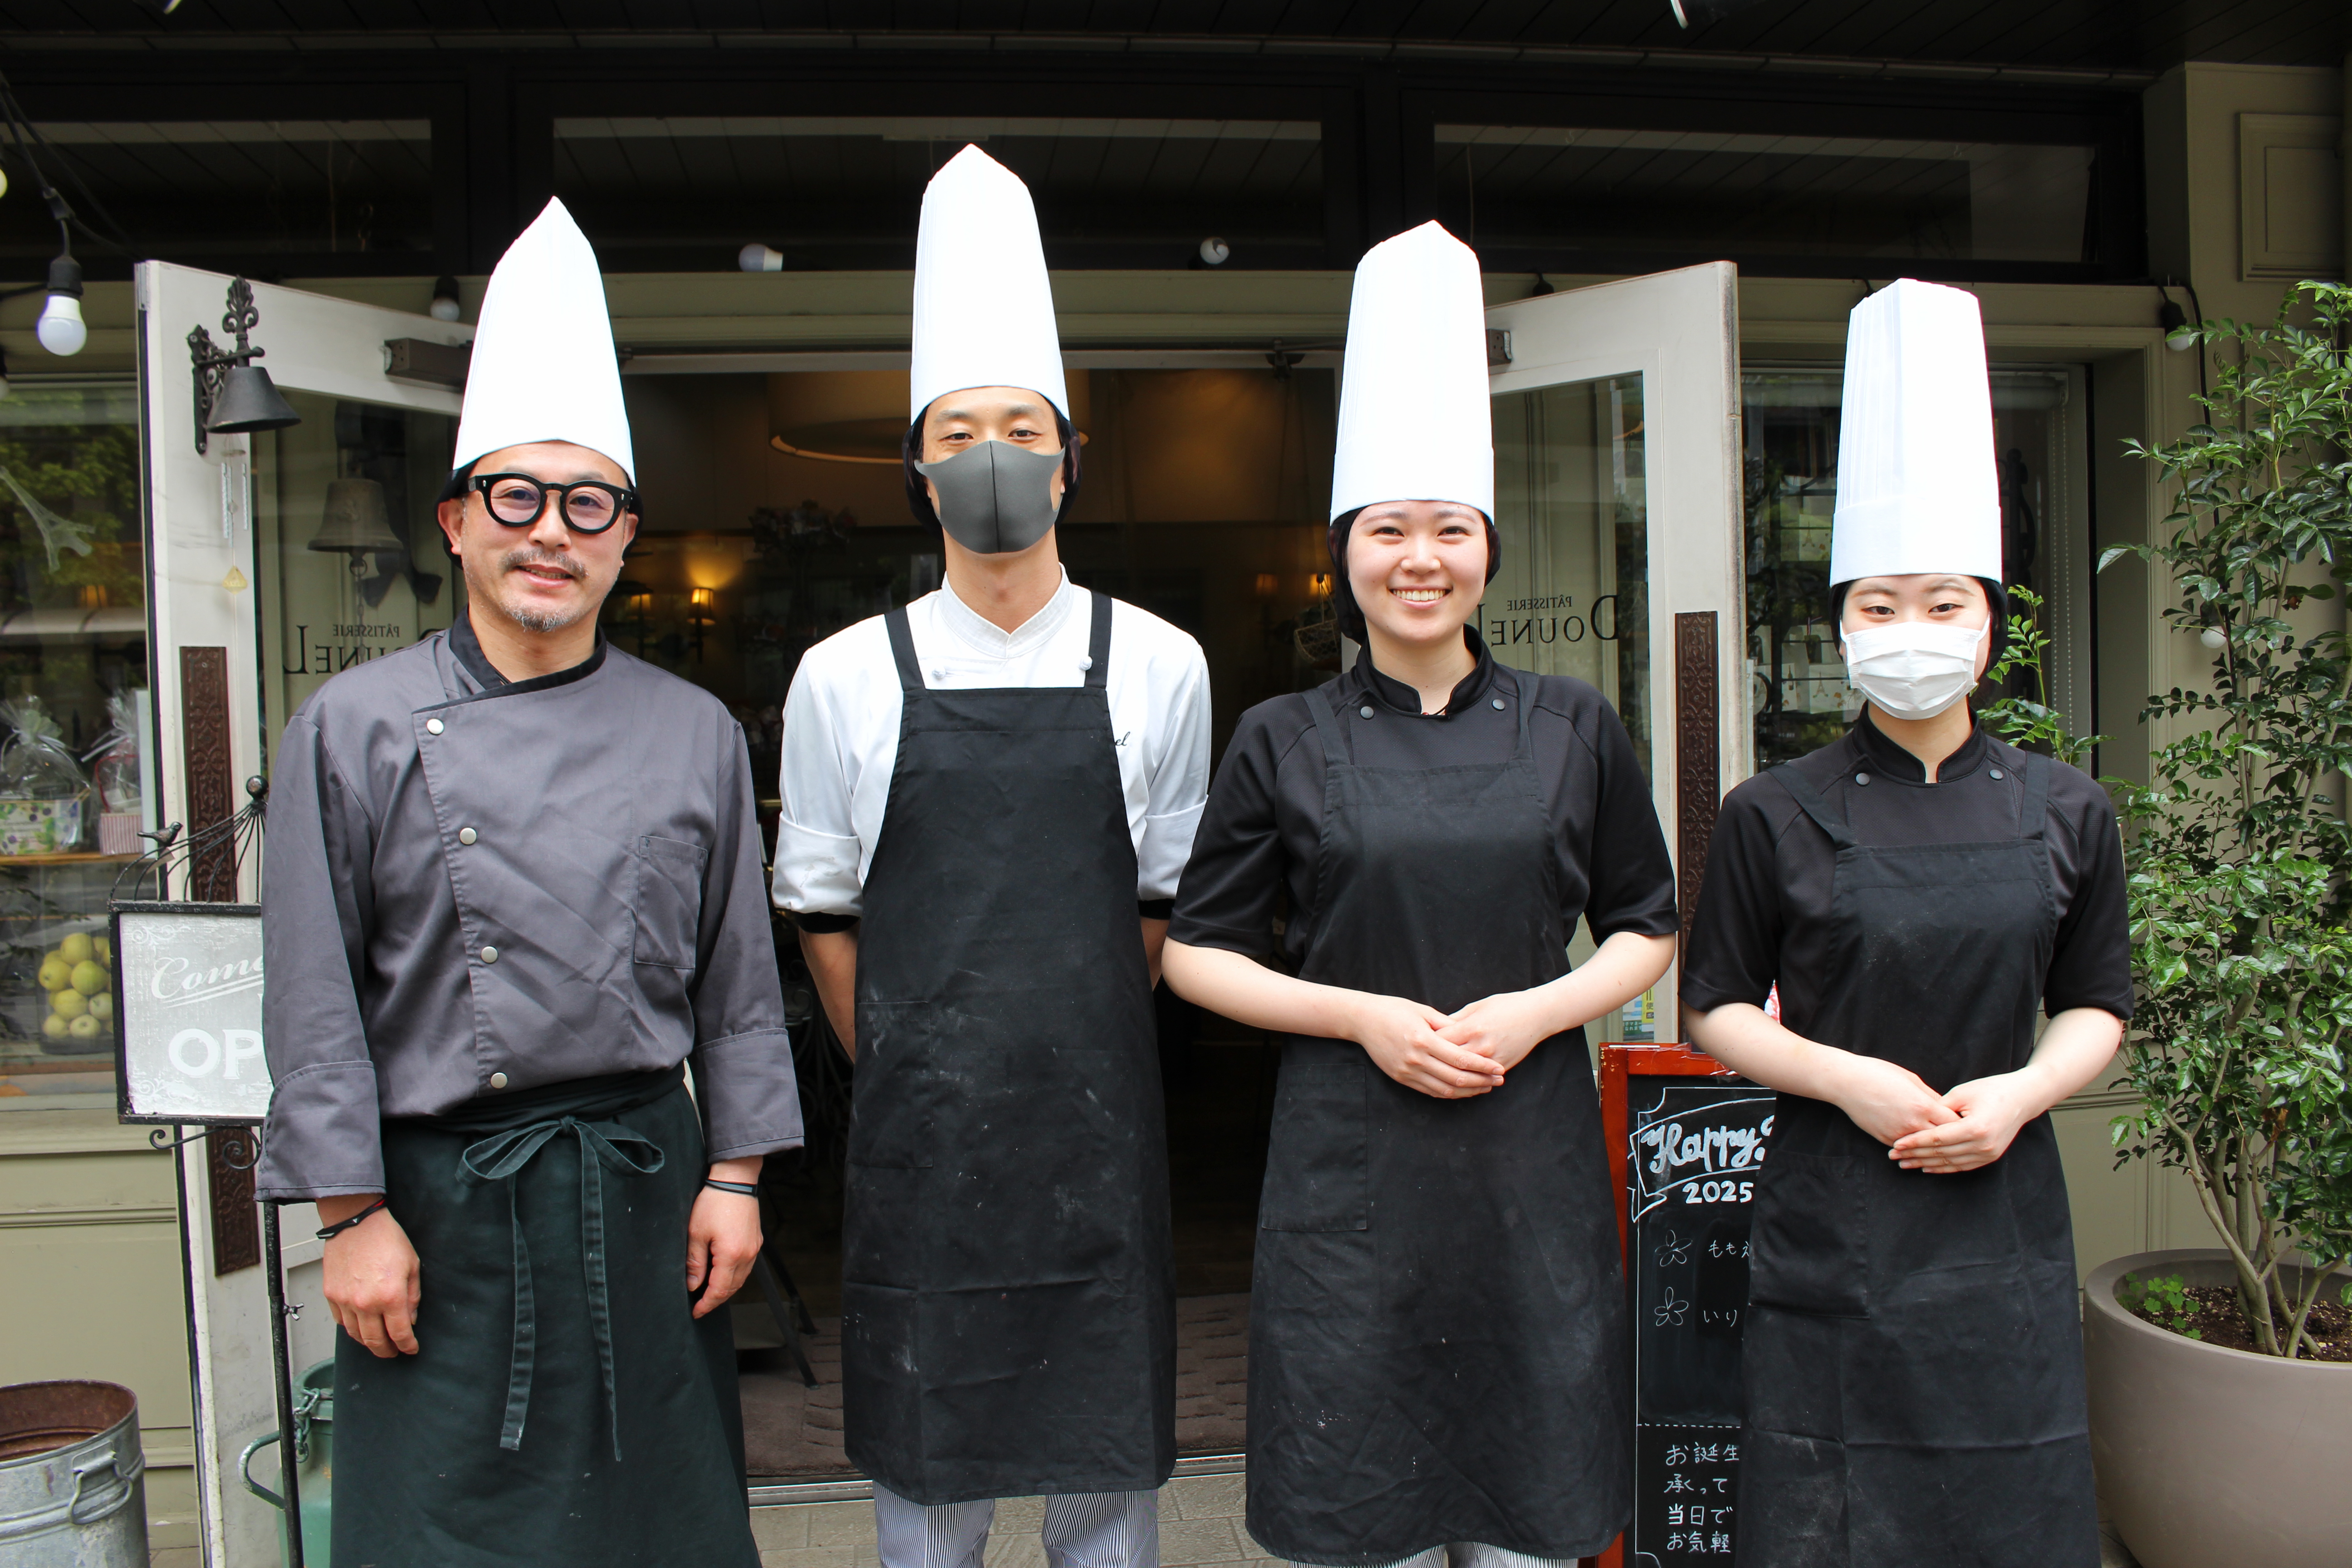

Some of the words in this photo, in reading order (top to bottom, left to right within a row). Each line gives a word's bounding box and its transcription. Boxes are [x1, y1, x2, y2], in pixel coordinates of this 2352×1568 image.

[168, 1028, 264, 1079] OP
[1682, 1181, 1754, 1204] 2025
[1666, 1442, 1740, 1466] お誕生
[1664, 1474, 1728, 1494] 承って
[1668, 1503, 1733, 1525] 当日で
[1667, 1531, 1731, 1553] お気軽
